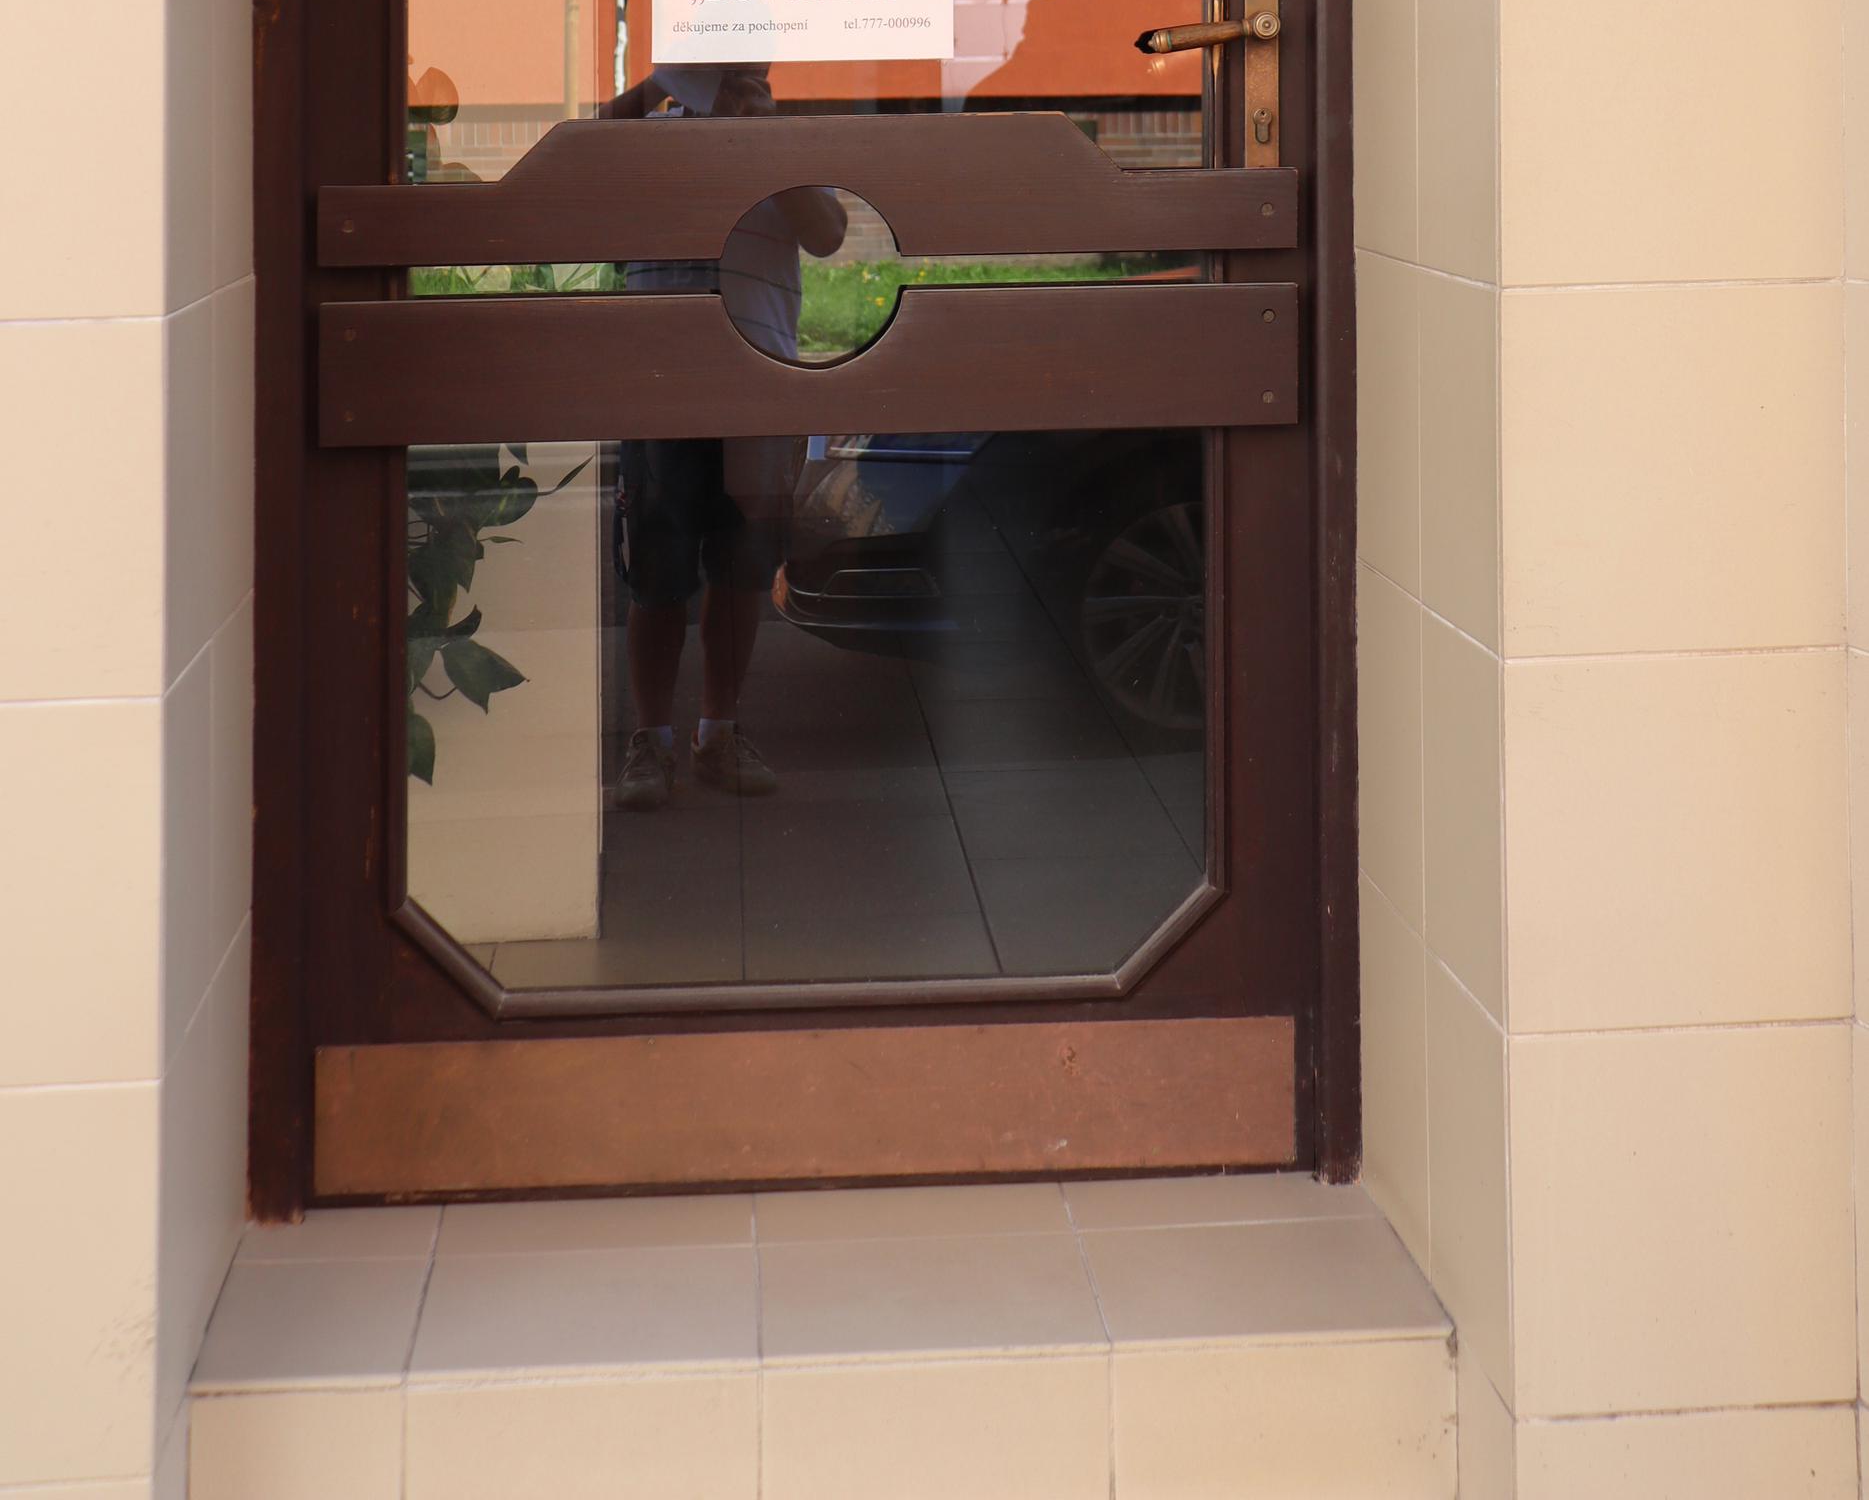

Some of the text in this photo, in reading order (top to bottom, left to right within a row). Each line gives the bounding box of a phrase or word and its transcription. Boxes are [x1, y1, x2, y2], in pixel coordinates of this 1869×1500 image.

[672, 20, 730, 35] děkujeme
[732, 22, 745, 32] za
[748, 20, 808, 34] pochopení
